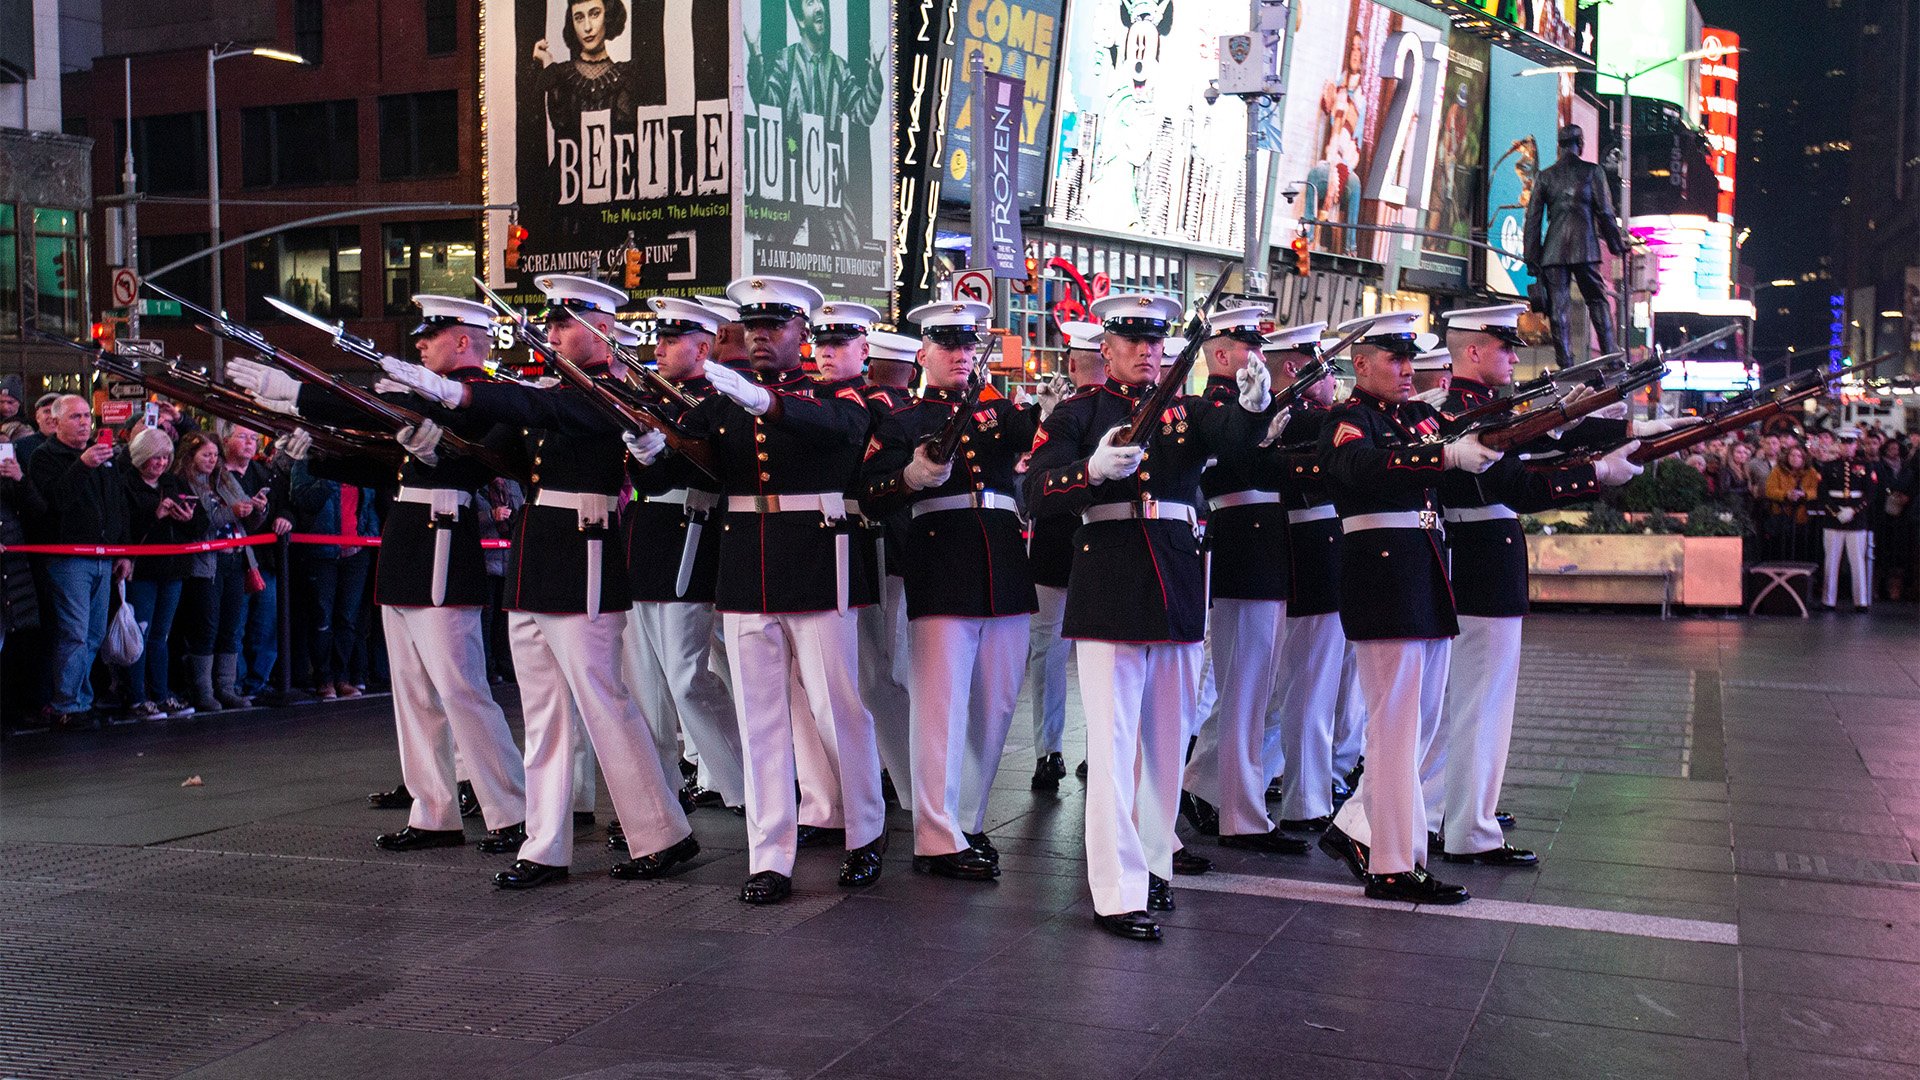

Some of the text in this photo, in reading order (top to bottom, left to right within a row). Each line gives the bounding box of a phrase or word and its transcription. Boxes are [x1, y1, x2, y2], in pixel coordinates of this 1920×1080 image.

[967, 0, 1053, 57] COME
[1376, 31, 1449, 210] 21
[558, 102, 728, 205] BEETLE
[992, 106, 1014, 245] FROZEN
[601, 209, 618, 223] The
[667, 205, 687, 218] The
[744, 204, 758, 222] The
[768, 249, 832, 273] JAW-DROPPING
[688, 286, 726, 297] BROADWAY
[1225, 299, 1243, 308] ONE
